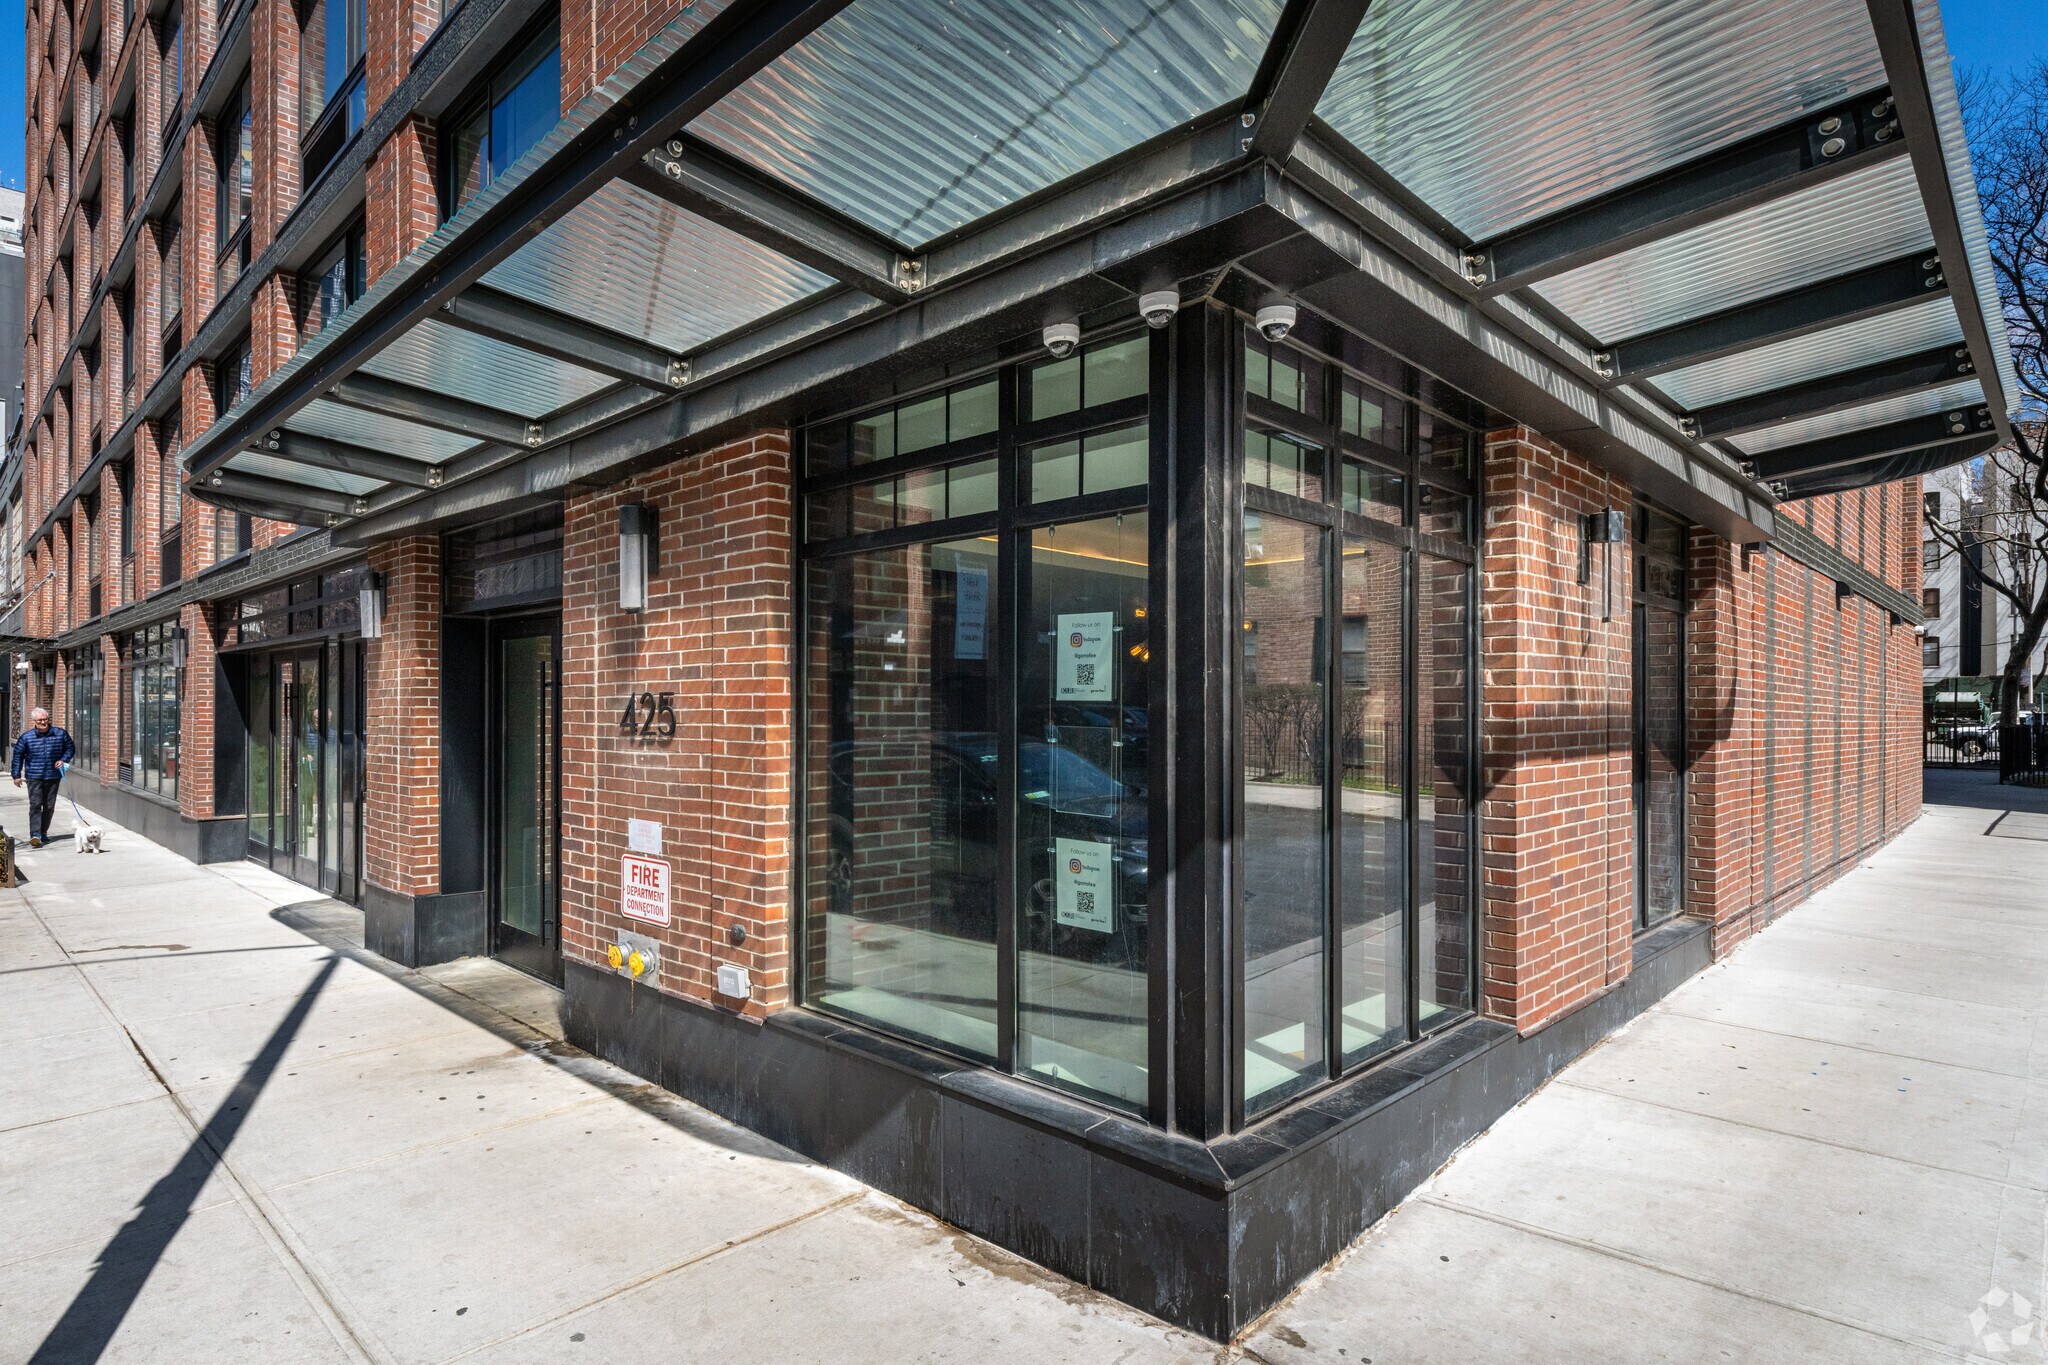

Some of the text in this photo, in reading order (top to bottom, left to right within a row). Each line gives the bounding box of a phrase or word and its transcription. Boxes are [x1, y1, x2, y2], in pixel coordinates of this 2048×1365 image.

[620, 692, 676, 736] 425
[631, 864, 660, 888] FIRE
[626, 885, 665, 903] DEPARTMENT
[626, 898, 664, 917] CONNECTION
